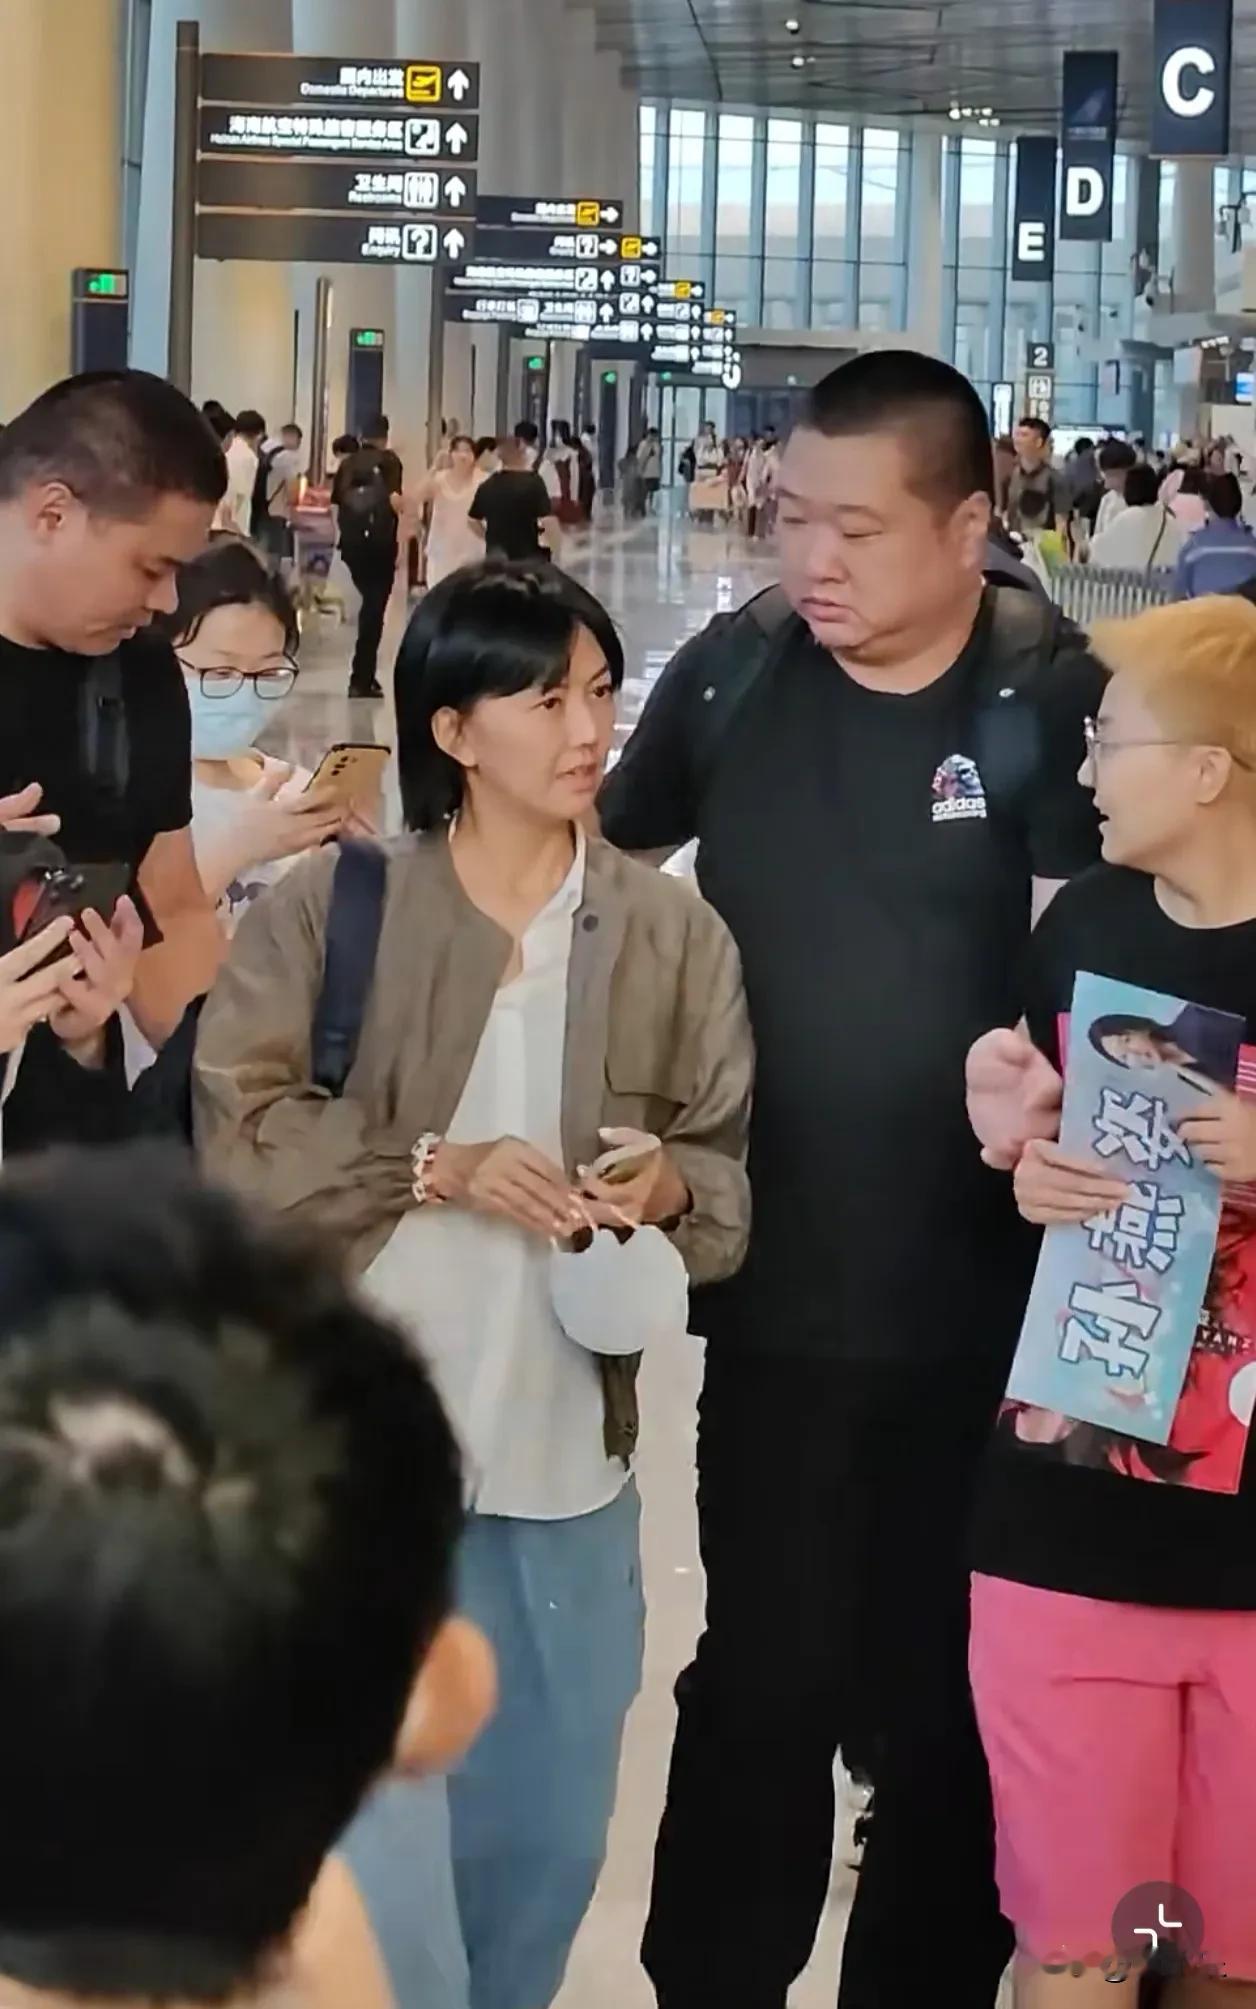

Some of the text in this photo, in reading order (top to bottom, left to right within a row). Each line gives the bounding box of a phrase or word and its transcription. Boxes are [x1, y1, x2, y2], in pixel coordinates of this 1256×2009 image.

[1162, 46, 1216, 118] C
[1066, 166, 1105, 217] D
[1018, 222, 1046, 262] E
[1033, 346, 1049, 367] 2
[932, 797, 986, 814] adidas
[1058, 1087, 1194, 1379] 孙燕姿
